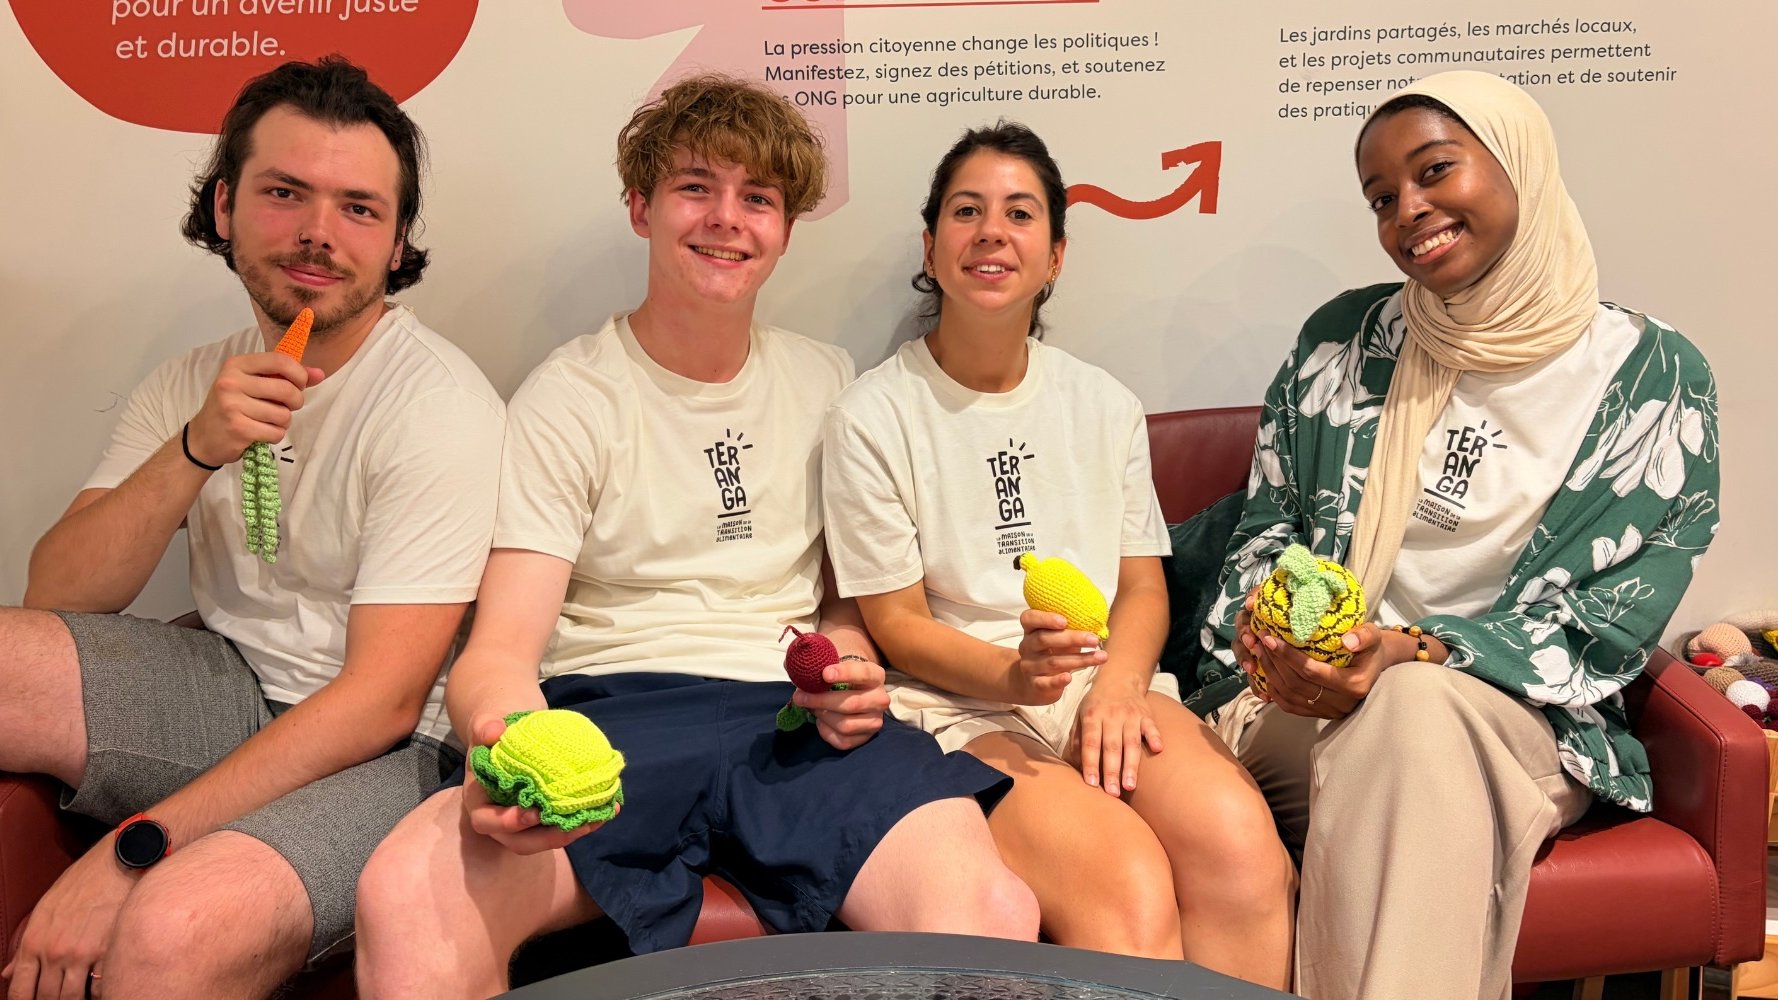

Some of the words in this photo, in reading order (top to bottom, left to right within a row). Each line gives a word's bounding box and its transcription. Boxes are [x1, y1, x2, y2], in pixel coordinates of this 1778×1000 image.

[111, 0, 183, 26] pour
[192, 0, 229, 16] un
[239, 0, 332, 15] avenir
[338, 0, 419, 21] juste
[115, 35, 148, 59] et
[157, 30, 286, 58] durable.
[1280, 27, 1308, 44] Les
[1309, 24, 1372, 46] jardins
[1376, 22, 1462, 43] partagés,
[1467, 21, 1490, 37] les
[1495, 18, 1570, 36] marchés
[1575, 18, 1637, 34] locaux,
[764, 40, 785, 56] La
[790, 38, 864, 60] pression
[869, 37, 957, 57] citoyenne
[962, 35, 1029, 54] change
[1034, 33, 1058, 50] les
[1063, 32, 1150, 52] politiques
[1278, 53, 1298, 69] et
[1302, 51, 1326, 68] les
[1331, 50, 1392, 71] projets
[1397, 45, 1546, 66] communautaires
[1551, 43, 1652, 64] permettent
[765, 64, 870, 82] Manifestez,
[875, 64, 933, 82] signez
[937, 61, 969, 78] des
[974, 60, 1056, 79] pétitions,
[1061, 60, 1080, 75] et
[1084, 58, 1166, 74] soutenez
[1278, 77, 1301, 94] de
[1306, 79, 1383, 96] repenser
[1556, 70, 1576, 85] et
[1580, 68, 1603, 84] de
[1606, 66, 1678, 83] soutenir
[794, 90, 837, 107] ONG
[842, 93, 884, 110] pour
[888, 92, 921, 105] une
[926, 87, 1023, 107] agriculture
[1028, 84, 1102, 101] durable.
[1278, 103, 1308, 119] des
[703, 441, 740, 469] TER
[1446, 426, 1488, 458] TER
[714, 466, 741, 489] AN
[986, 450, 1021, 478] TER
[1442, 451, 1481, 479] AN
[721, 485, 747, 511] GA
[995, 475, 1022, 500] AN
[1435, 475, 1469, 500] GA
[999, 497, 1025, 522] GA
